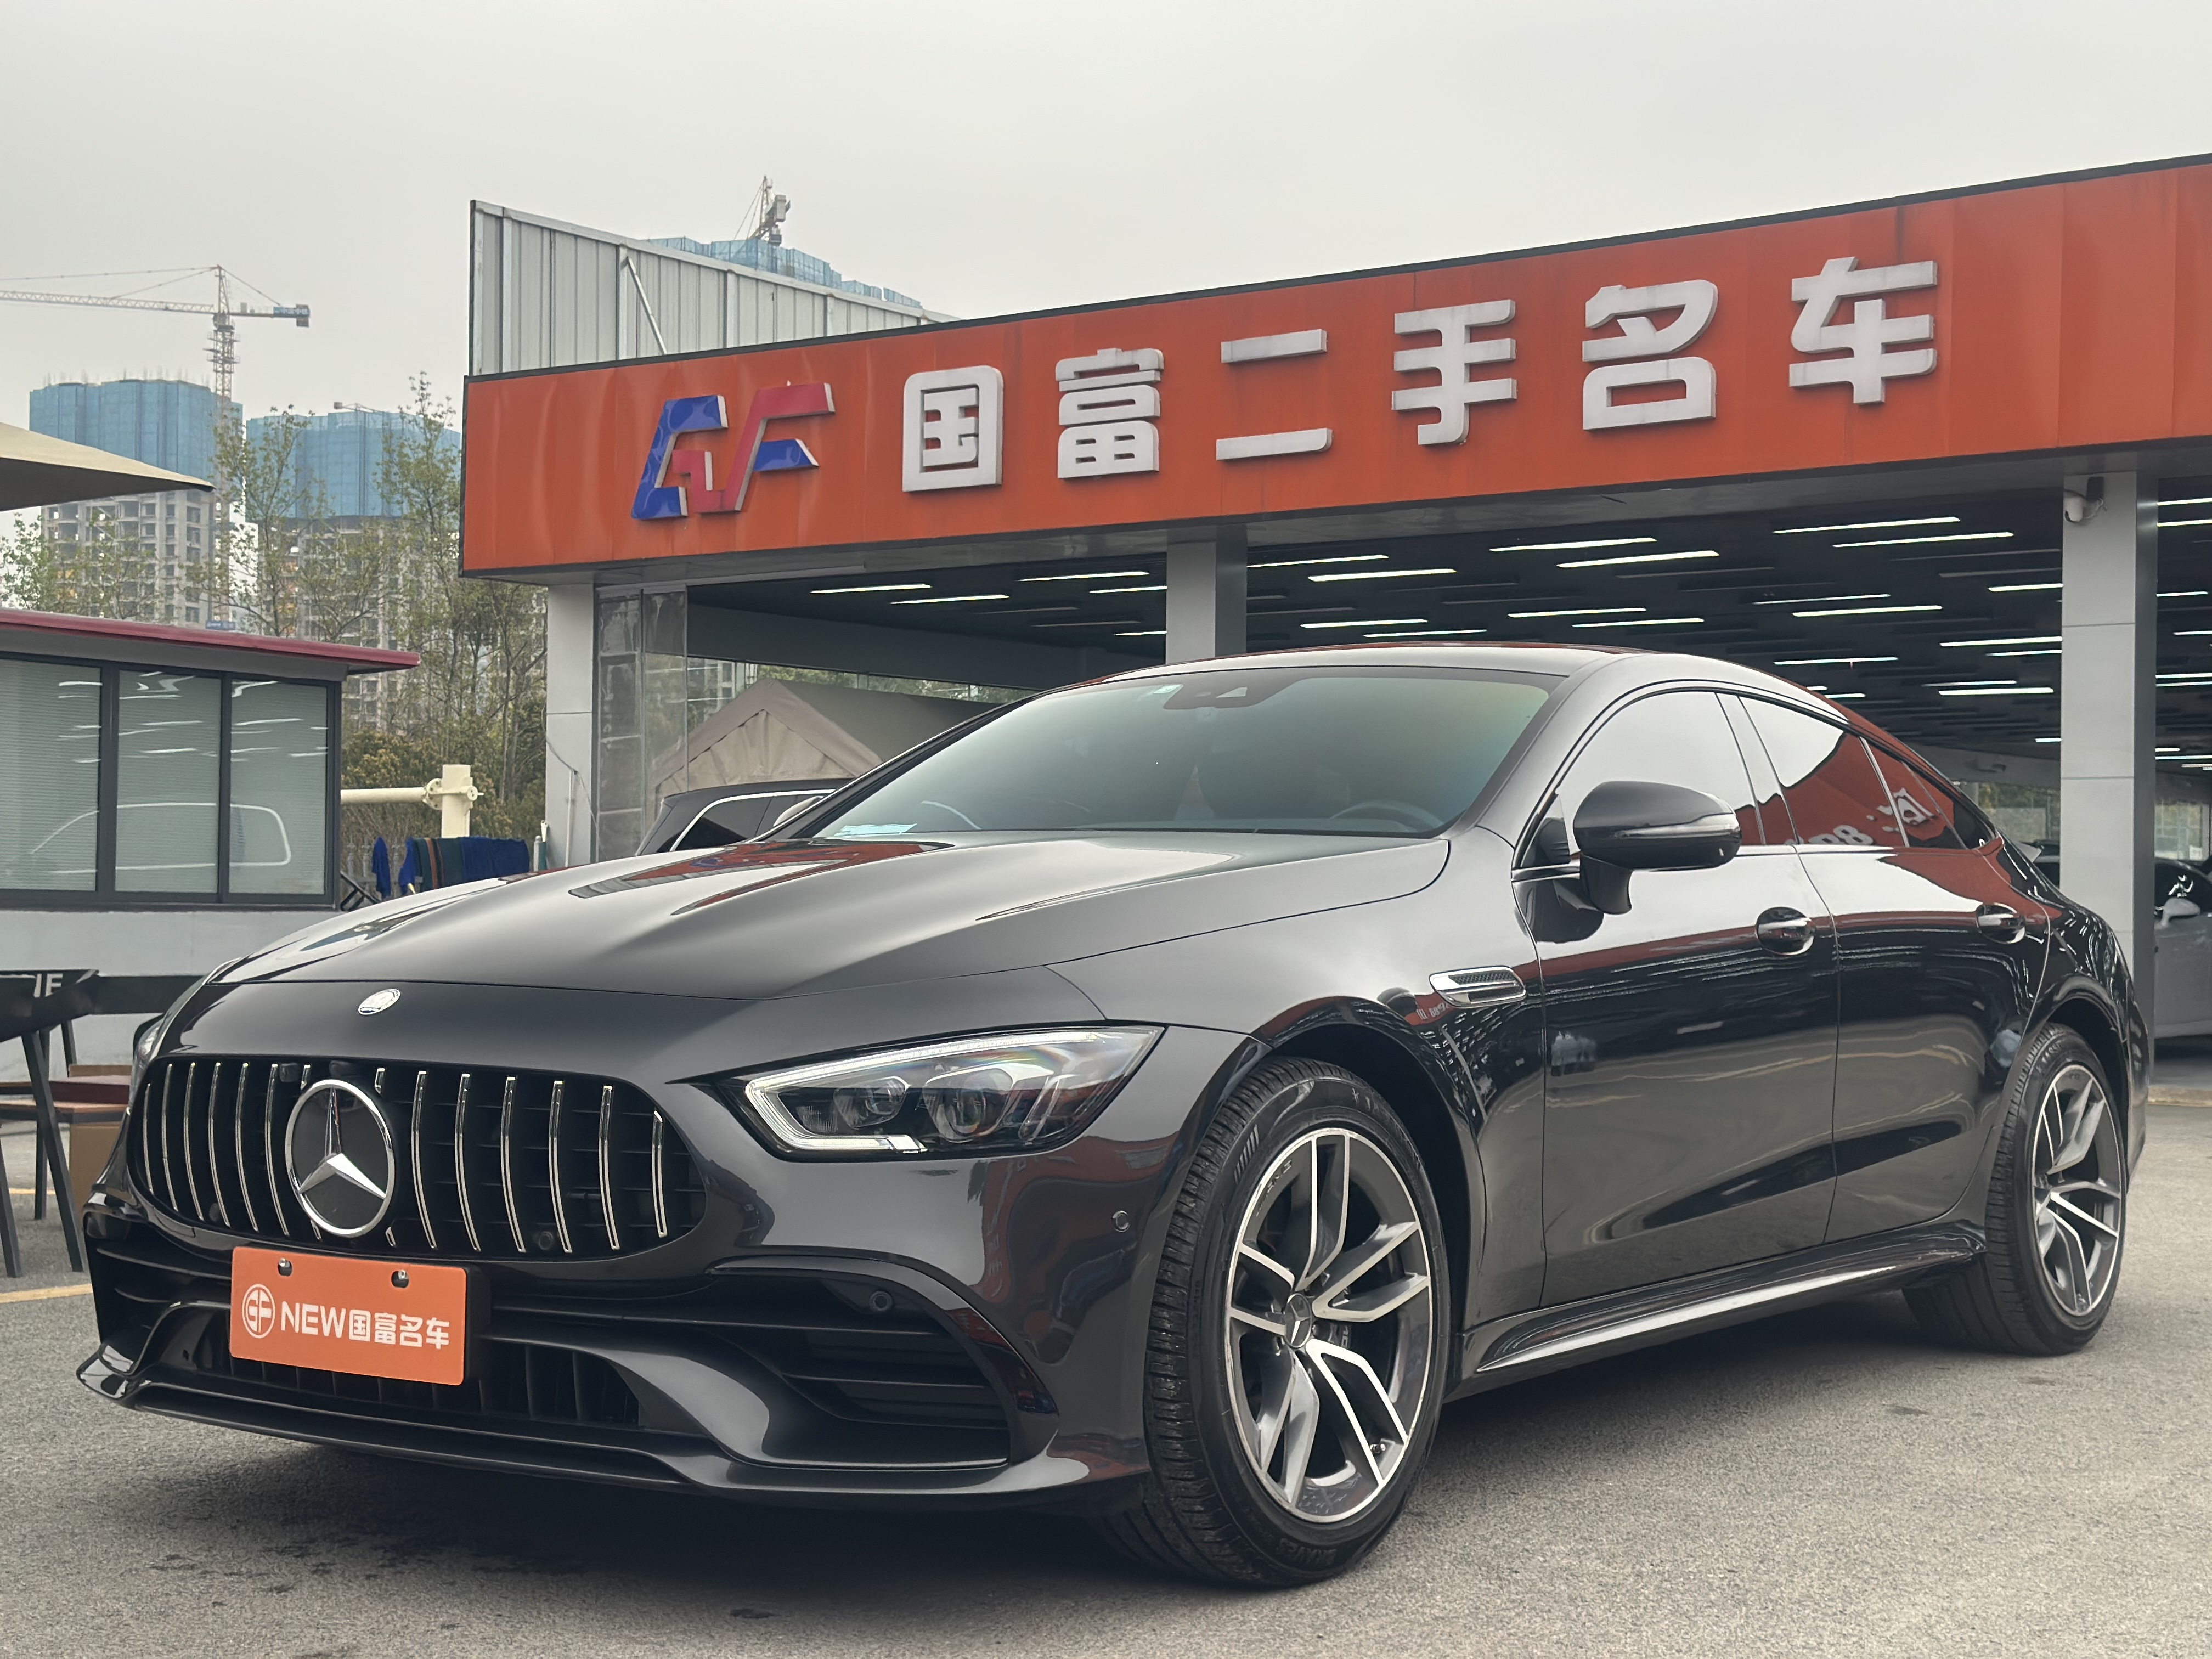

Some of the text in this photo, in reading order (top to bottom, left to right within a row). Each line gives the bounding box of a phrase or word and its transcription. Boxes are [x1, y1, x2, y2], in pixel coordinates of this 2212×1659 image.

[902, 256, 1938, 492] 国富二手名车
